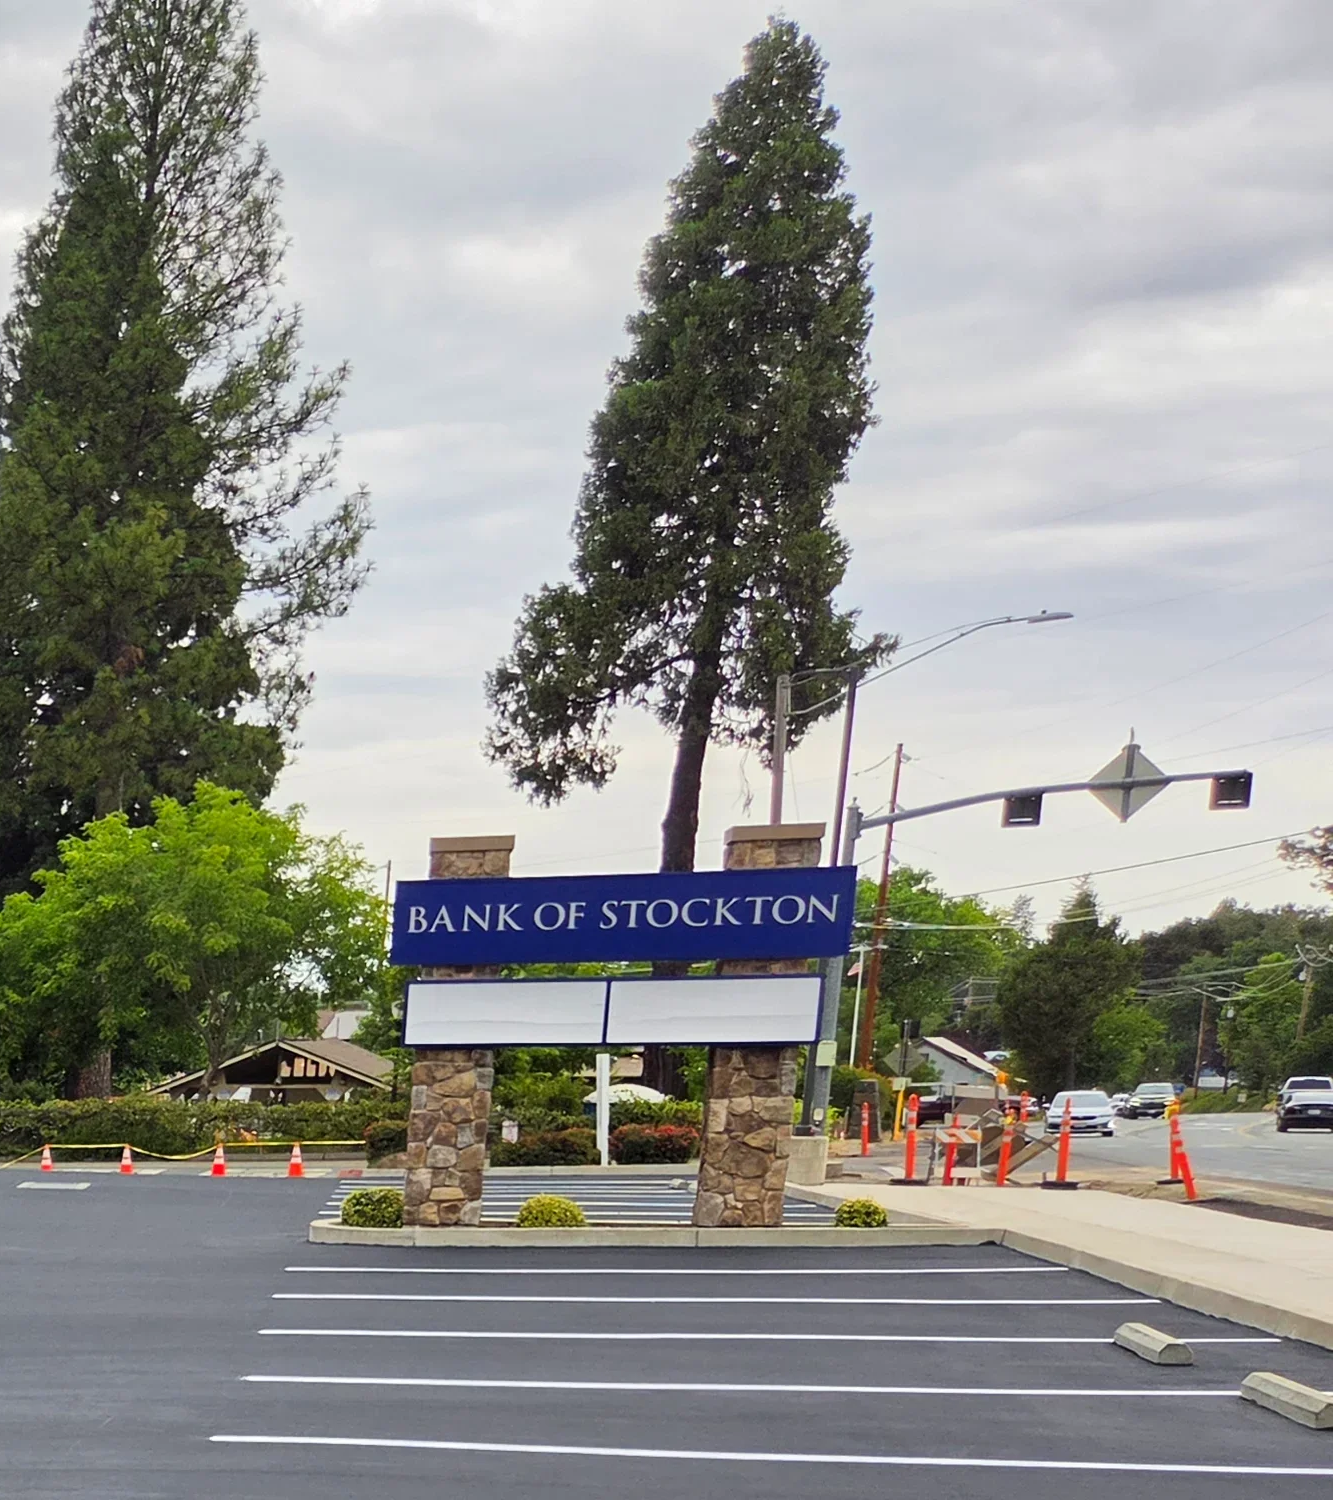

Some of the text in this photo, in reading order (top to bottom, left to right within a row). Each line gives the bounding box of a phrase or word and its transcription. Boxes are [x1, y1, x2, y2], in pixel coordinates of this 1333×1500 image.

[407, 894, 840, 934] BANK OF STOCKTON
